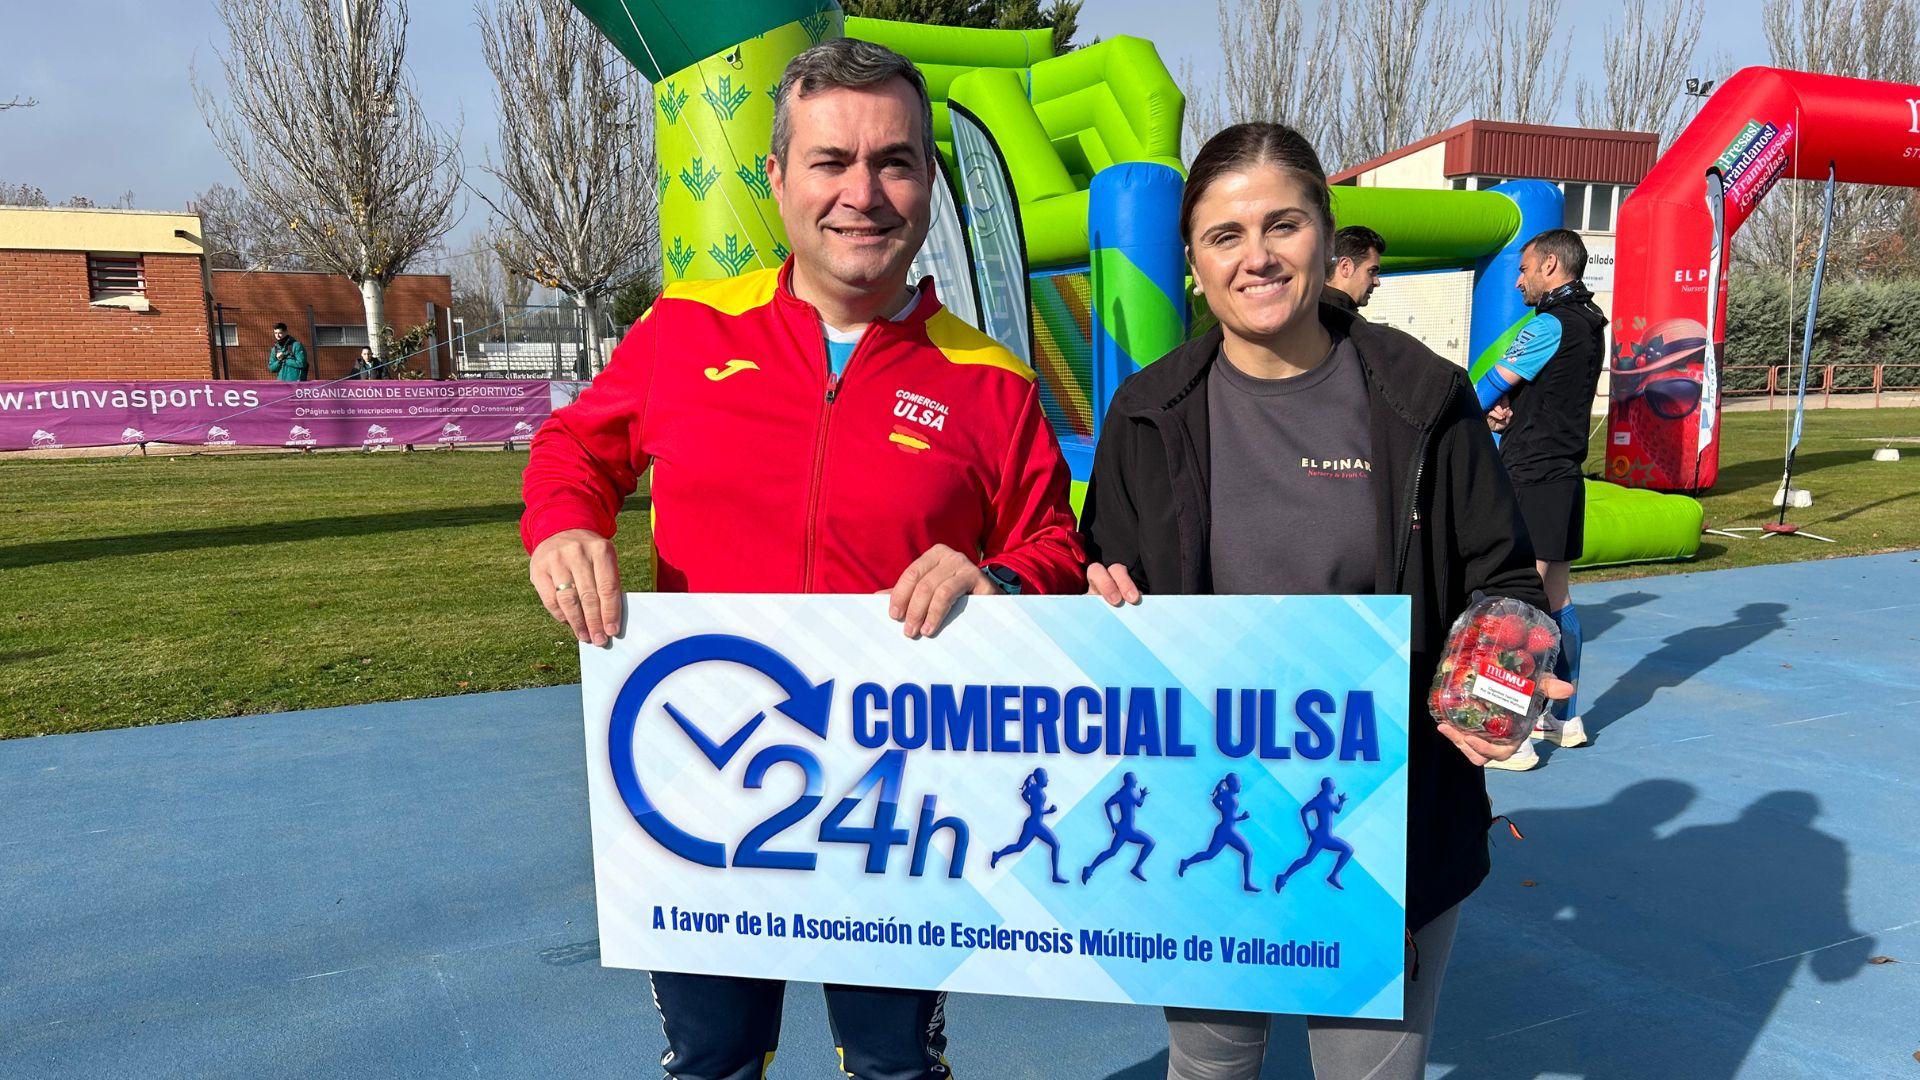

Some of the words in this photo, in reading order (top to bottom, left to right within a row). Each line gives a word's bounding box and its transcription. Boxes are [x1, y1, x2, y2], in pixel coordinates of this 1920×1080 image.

[1719, 122, 1760, 170] ¡Fresas!
[1723, 125, 1776, 193] Arándanos!
[1731, 123, 1794, 204] ¡Frambuesas!
[1739, 148, 1786, 213] ¡Grosellas!
[1674, 269, 1693, 282] EL
[295, 387, 383, 399] ORGANIZACIÓN
[386, 388, 401, 398] DE
[404, 387, 455, 398] EVENTOS
[458, 386, 525, 397] DEPORTIVOS
[305, 408, 329, 416] Página
[357, 407, 402, 416] inscripciones
[481, 405, 525, 413] Cronometraje
[893, 400, 945, 432] ULSA
[895, 389, 949, 415] COMERCIAL
[1301, 458, 1318, 468] EL
[1322, 458, 1372, 472] PINAR
[852, 682, 1197, 757] COMERCIAL
[1216, 688, 1380, 762] ULSA
[732, 744, 969, 879] 24h
[652, 906, 666, 930] A
[670, 906, 730, 934] favor
[736, 911, 762, 936] de
[767, 912, 787, 937] la
[792, 914, 912, 945] Asociación
[918, 921, 945, 947] de
[951, 922, 1073, 955] Esclerosis
[1080, 928, 1177, 964] Múltiple
[1183, 934, 1213, 963] de
[1219, 936, 1340, 969] Valladolid
